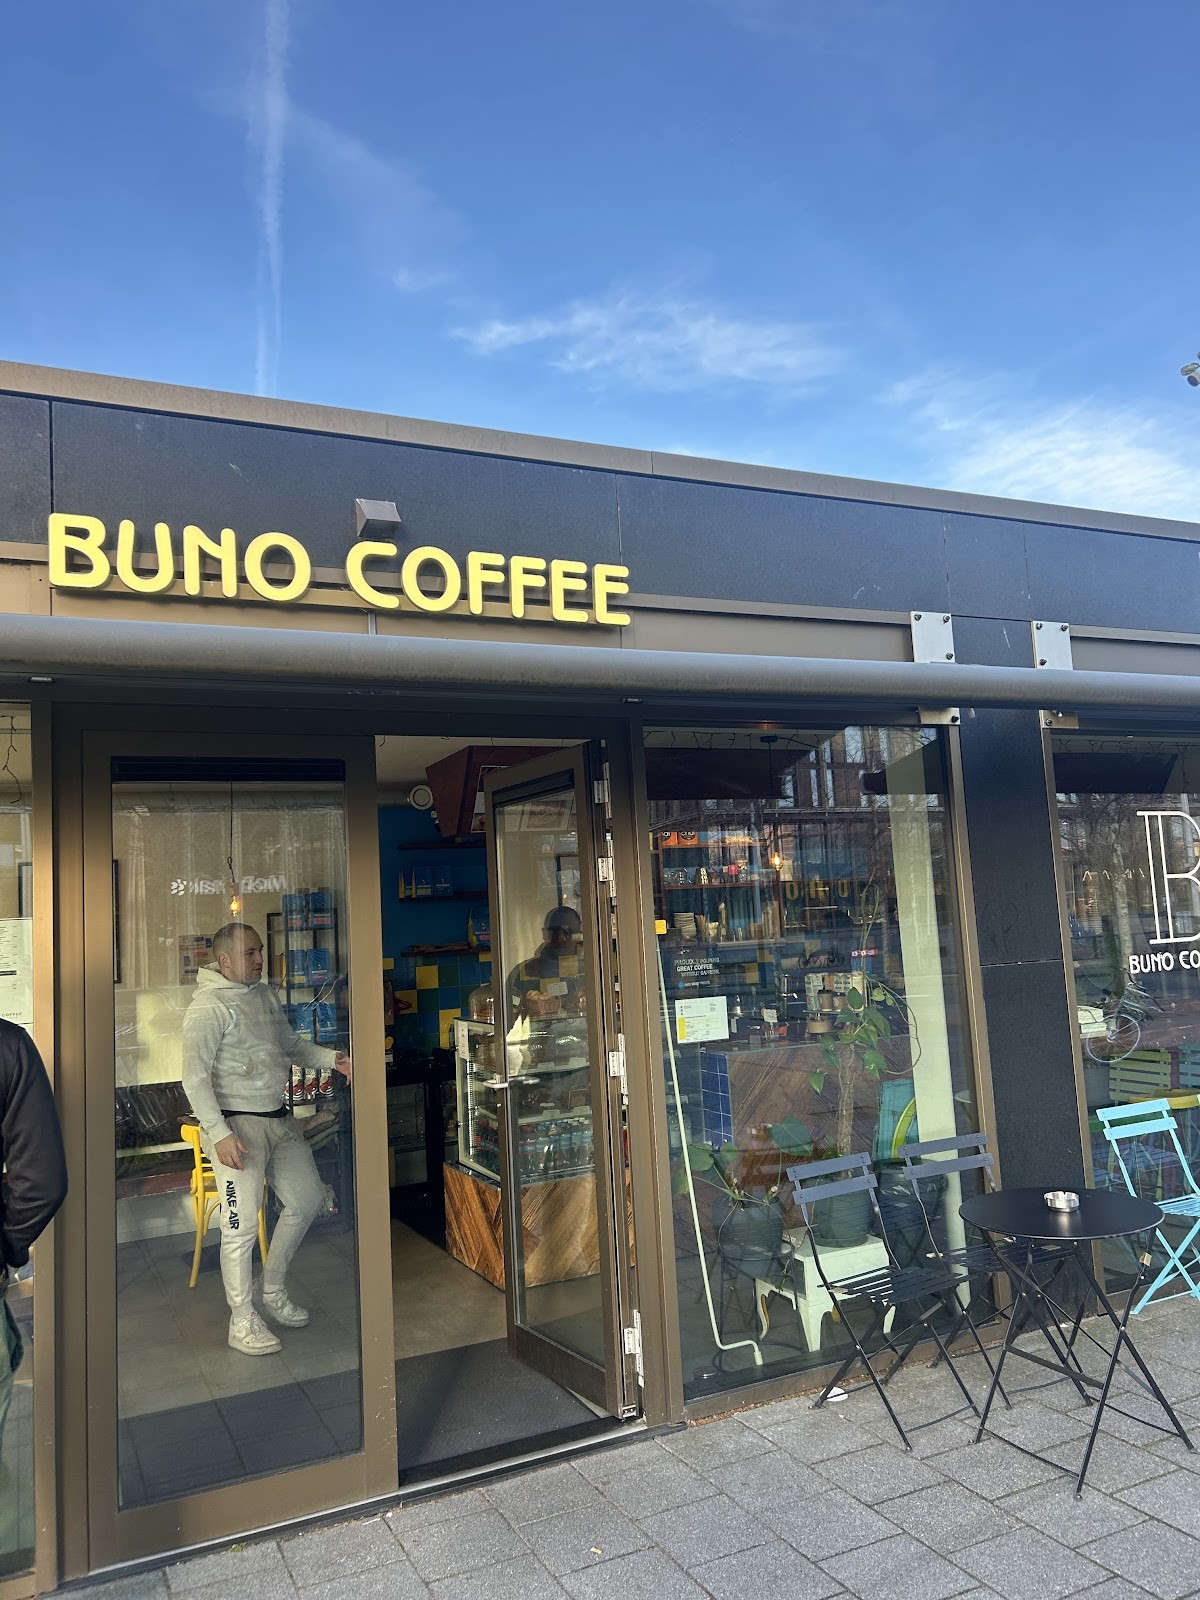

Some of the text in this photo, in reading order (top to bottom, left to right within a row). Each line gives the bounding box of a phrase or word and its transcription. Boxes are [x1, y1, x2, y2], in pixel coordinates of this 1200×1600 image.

[48, 513, 632, 627] BUNO COFFEE
[694, 963, 713, 971] COFFEE
[1129, 952, 1174, 974] BUNO
[226, 1180, 240, 1230] NIKE AIR
